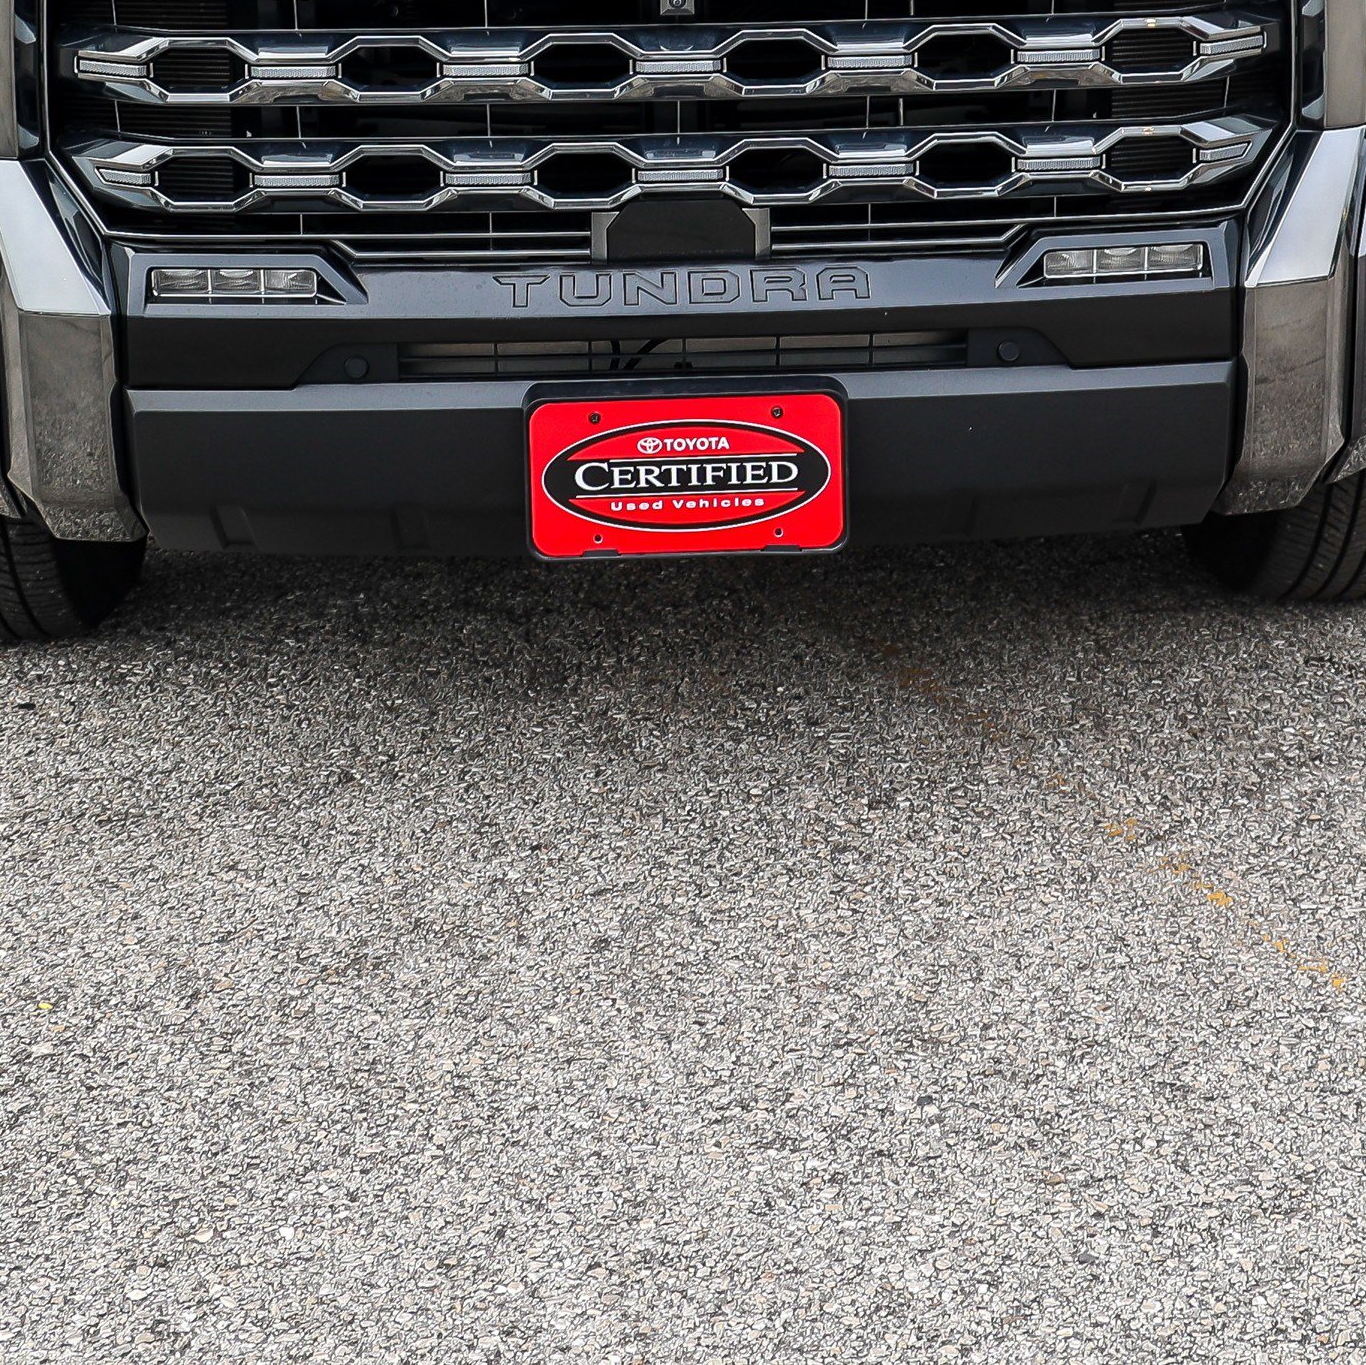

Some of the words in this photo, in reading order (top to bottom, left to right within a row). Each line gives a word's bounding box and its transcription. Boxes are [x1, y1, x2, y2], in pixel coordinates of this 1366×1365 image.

[492, 266, 872, 308] TUNDRA
[663, 436, 730, 452] TOYOTA
[574, 461, 799, 492] CERTIFIED
[610, 499, 663, 512] Used
[672, 497, 765, 510] Vehicles
